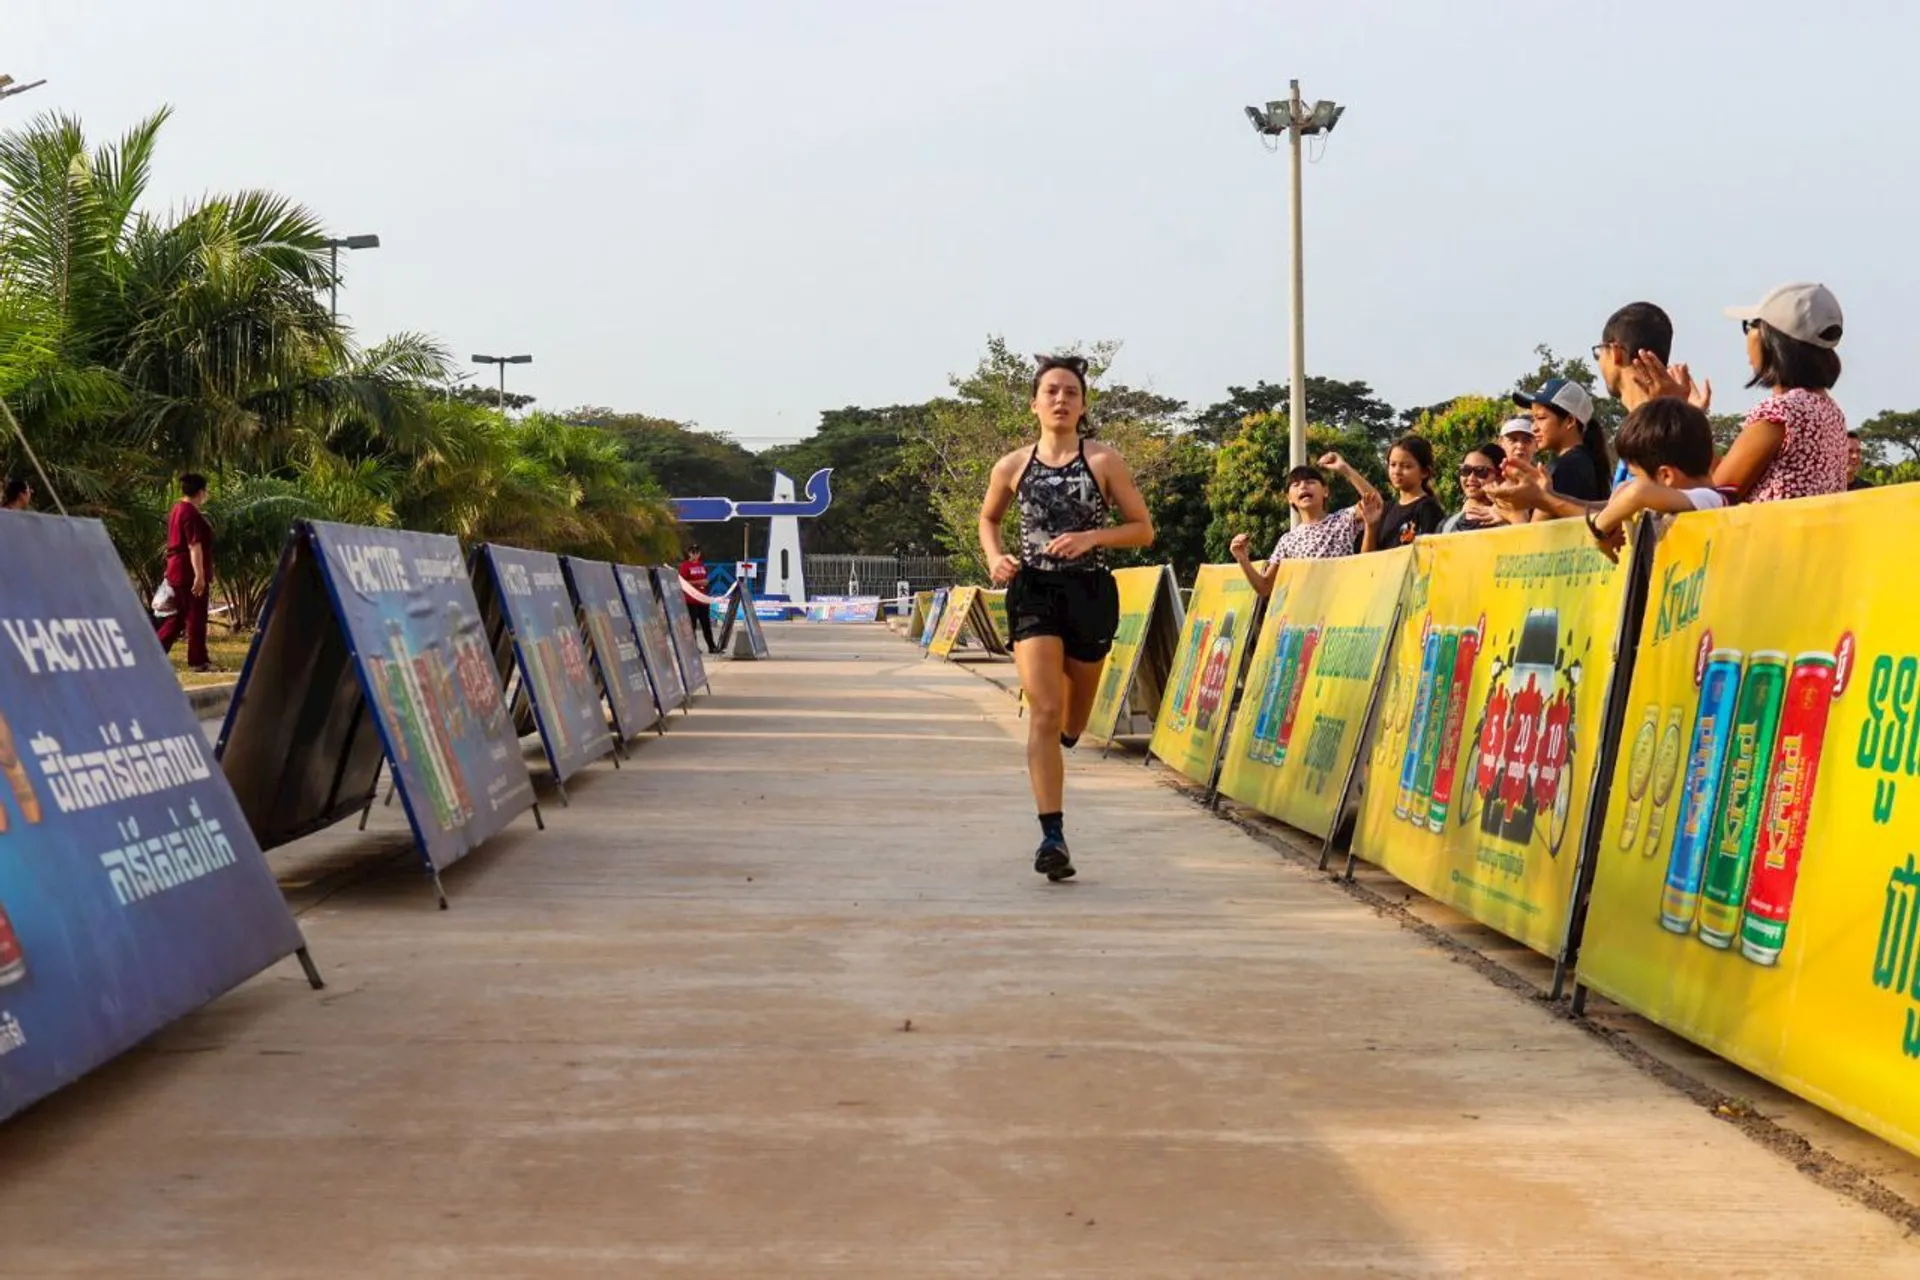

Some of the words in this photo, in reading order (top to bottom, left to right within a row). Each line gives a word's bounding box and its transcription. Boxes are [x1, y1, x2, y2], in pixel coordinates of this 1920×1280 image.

[337, 544, 411, 593] V-ACTIVE
[1652, 540, 1711, 645] Krud
[1, 617, 136, 674] V-ACTIVE
[1513, 713, 1532, 754] 20
[1546, 723, 1563, 760] 10
[1765, 732, 1804, 871] Krud
